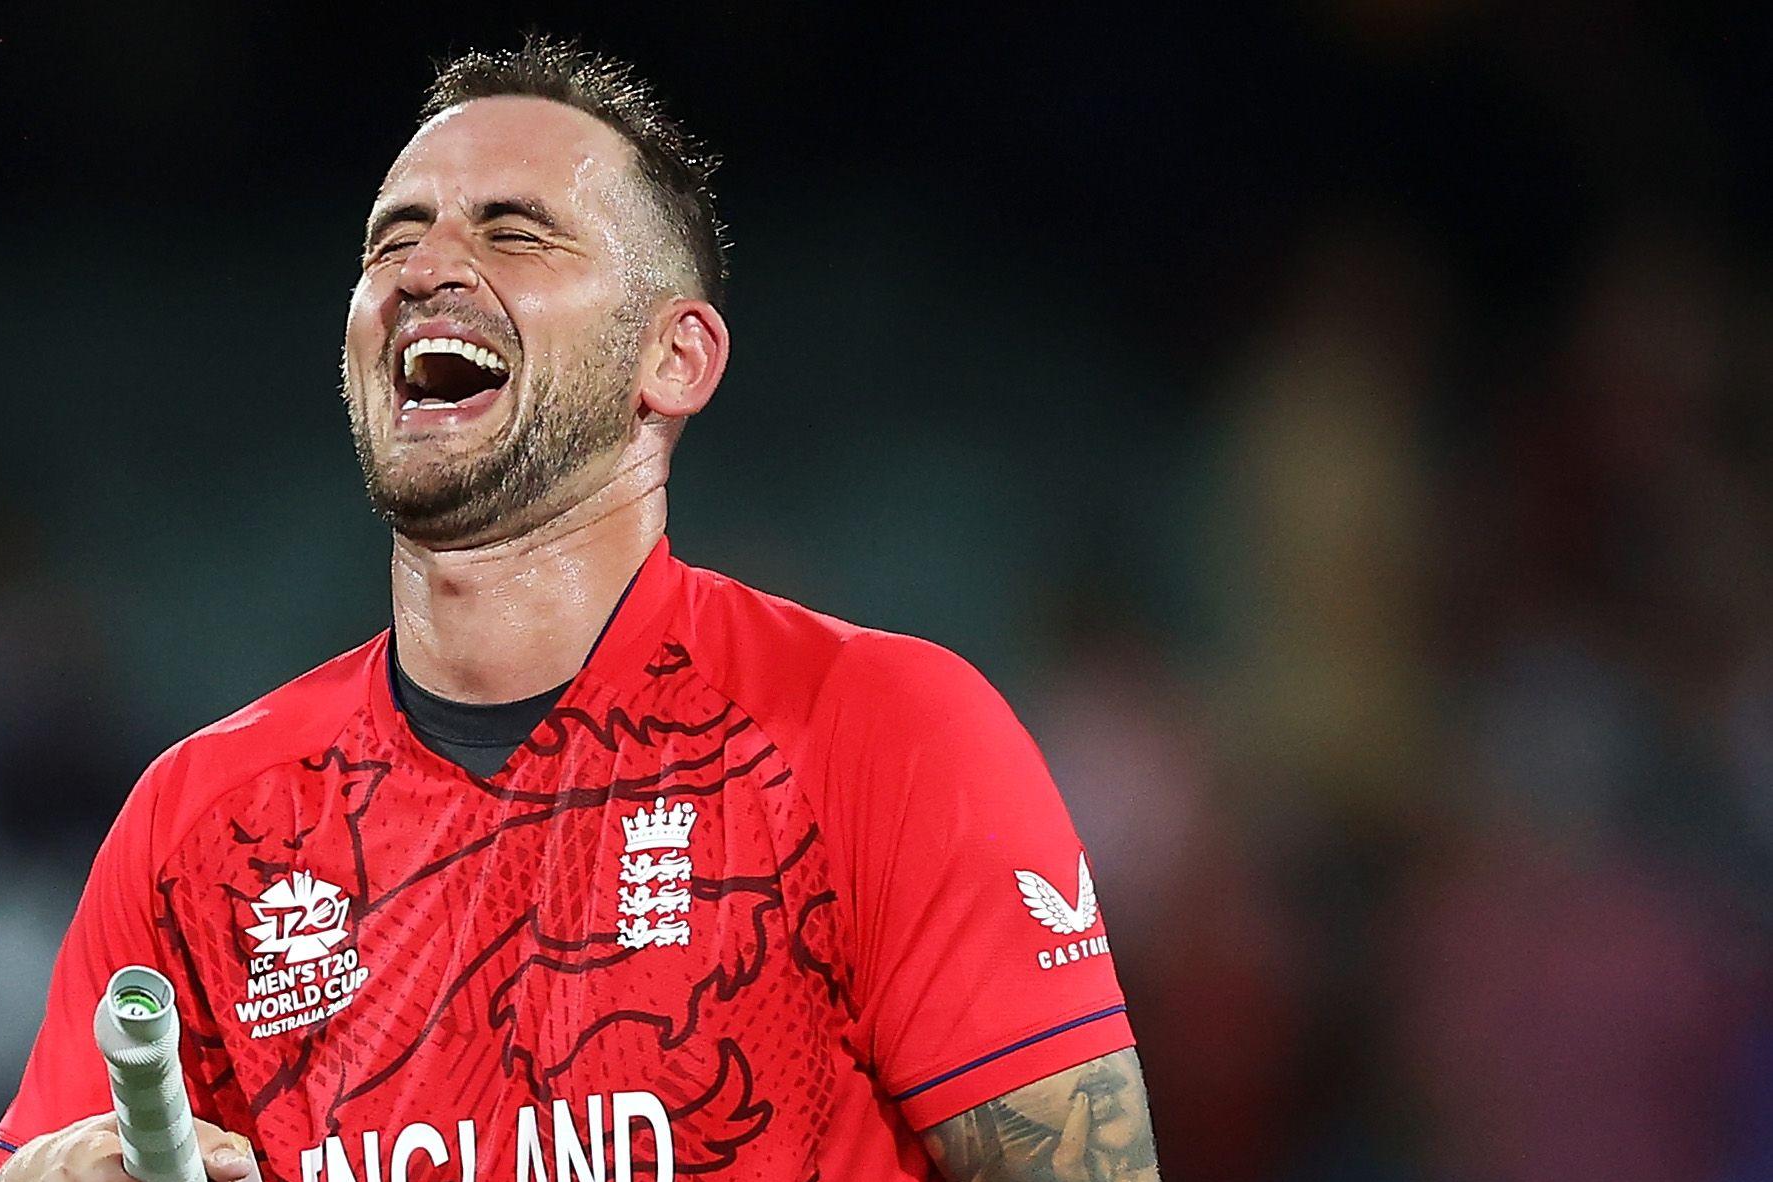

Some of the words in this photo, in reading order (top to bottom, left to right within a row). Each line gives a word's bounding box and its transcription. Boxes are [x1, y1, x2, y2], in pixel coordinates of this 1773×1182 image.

[247, 962, 316, 999] MEN'S
[319, 949, 358, 979] T20
[250, 954, 274, 975] ICC
[235, 985, 321, 1023] WORLD
[324, 967, 369, 999] CUP
[251, 1007, 325, 1039] AUSTRALIA
